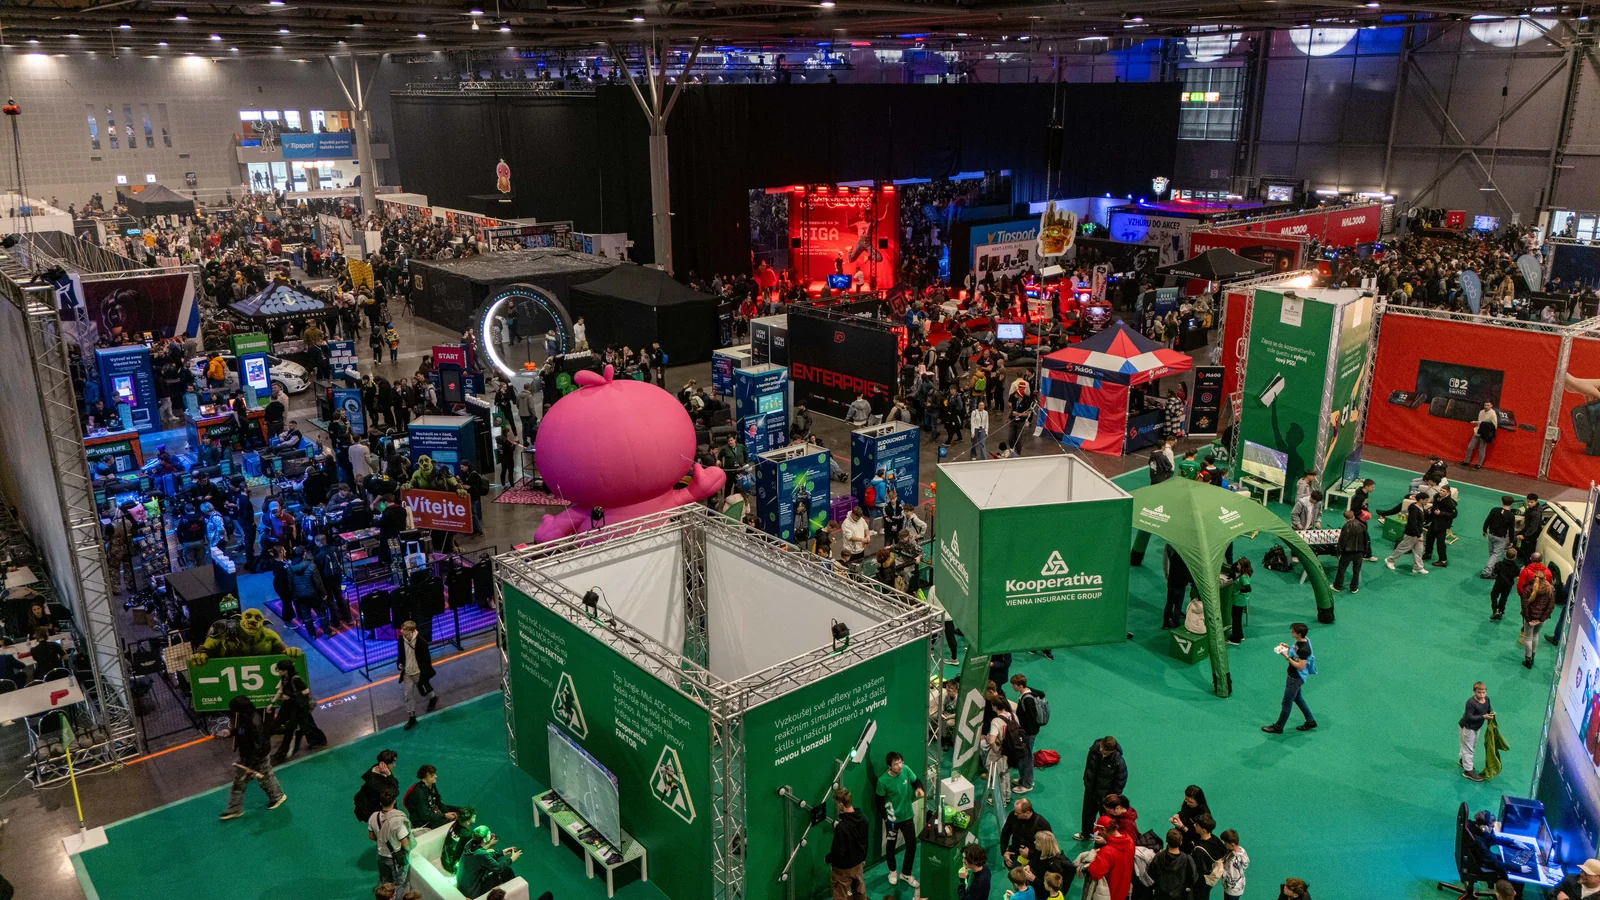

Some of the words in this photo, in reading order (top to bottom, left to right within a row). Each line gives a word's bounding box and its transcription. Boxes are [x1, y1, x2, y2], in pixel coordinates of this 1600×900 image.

[1280, 224, 1307, 235] HAL3000
[1341, 216, 1366, 227] HAL3000
[997, 227, 1036, 243] Tipsport
[1194, 244, 1236, 254] HAL0
[1261, 337, 1272, 347] Zapoj
[1460, 380, 1468, 390] 2
[877, 434, 907, 446] BUDOUCNOST
[406, 496, 465, 518] Vítejte
[940, 538, 969, 584] Kooperativa
[1006, 572, 1103, 593] Kooperativa
[1006, 598, 1033, 606] VIENNA
[1034, 594, 1075, 604] INSURANCE
[1077, 592, 1102, 600] GROUP
[519, 630, 545, 652] Kooperativa
[199, 665, 264, 692] -15
[319, 695, 358, 710] XZONE
[629, 695, 639, 706] role
[774, 706, 812, 729] Vyzkoušej
[814, 701, 826, 712] své
[827, 690, 852, 706] reflexy
[853, 686, 861, 695] na
[862, 676, 885, 689] našem
[774, 722, 809, 741] reakčním
[810, 704, 850, 726] simulátoru,
[852, 693, 867, 707] ukaž
[869, 686, 886, 699] další
[615, 717, 647, 745] Kooperativa
[775, 739, 795, 754] skills
[803, 724, 826, 740] našich
[828, 710, 858, 731] partnerů
[865, 696, 887, 712] vyhraj
[775, 751, 799, 766] novou
[801, 733, 832, 754] konzoli!
